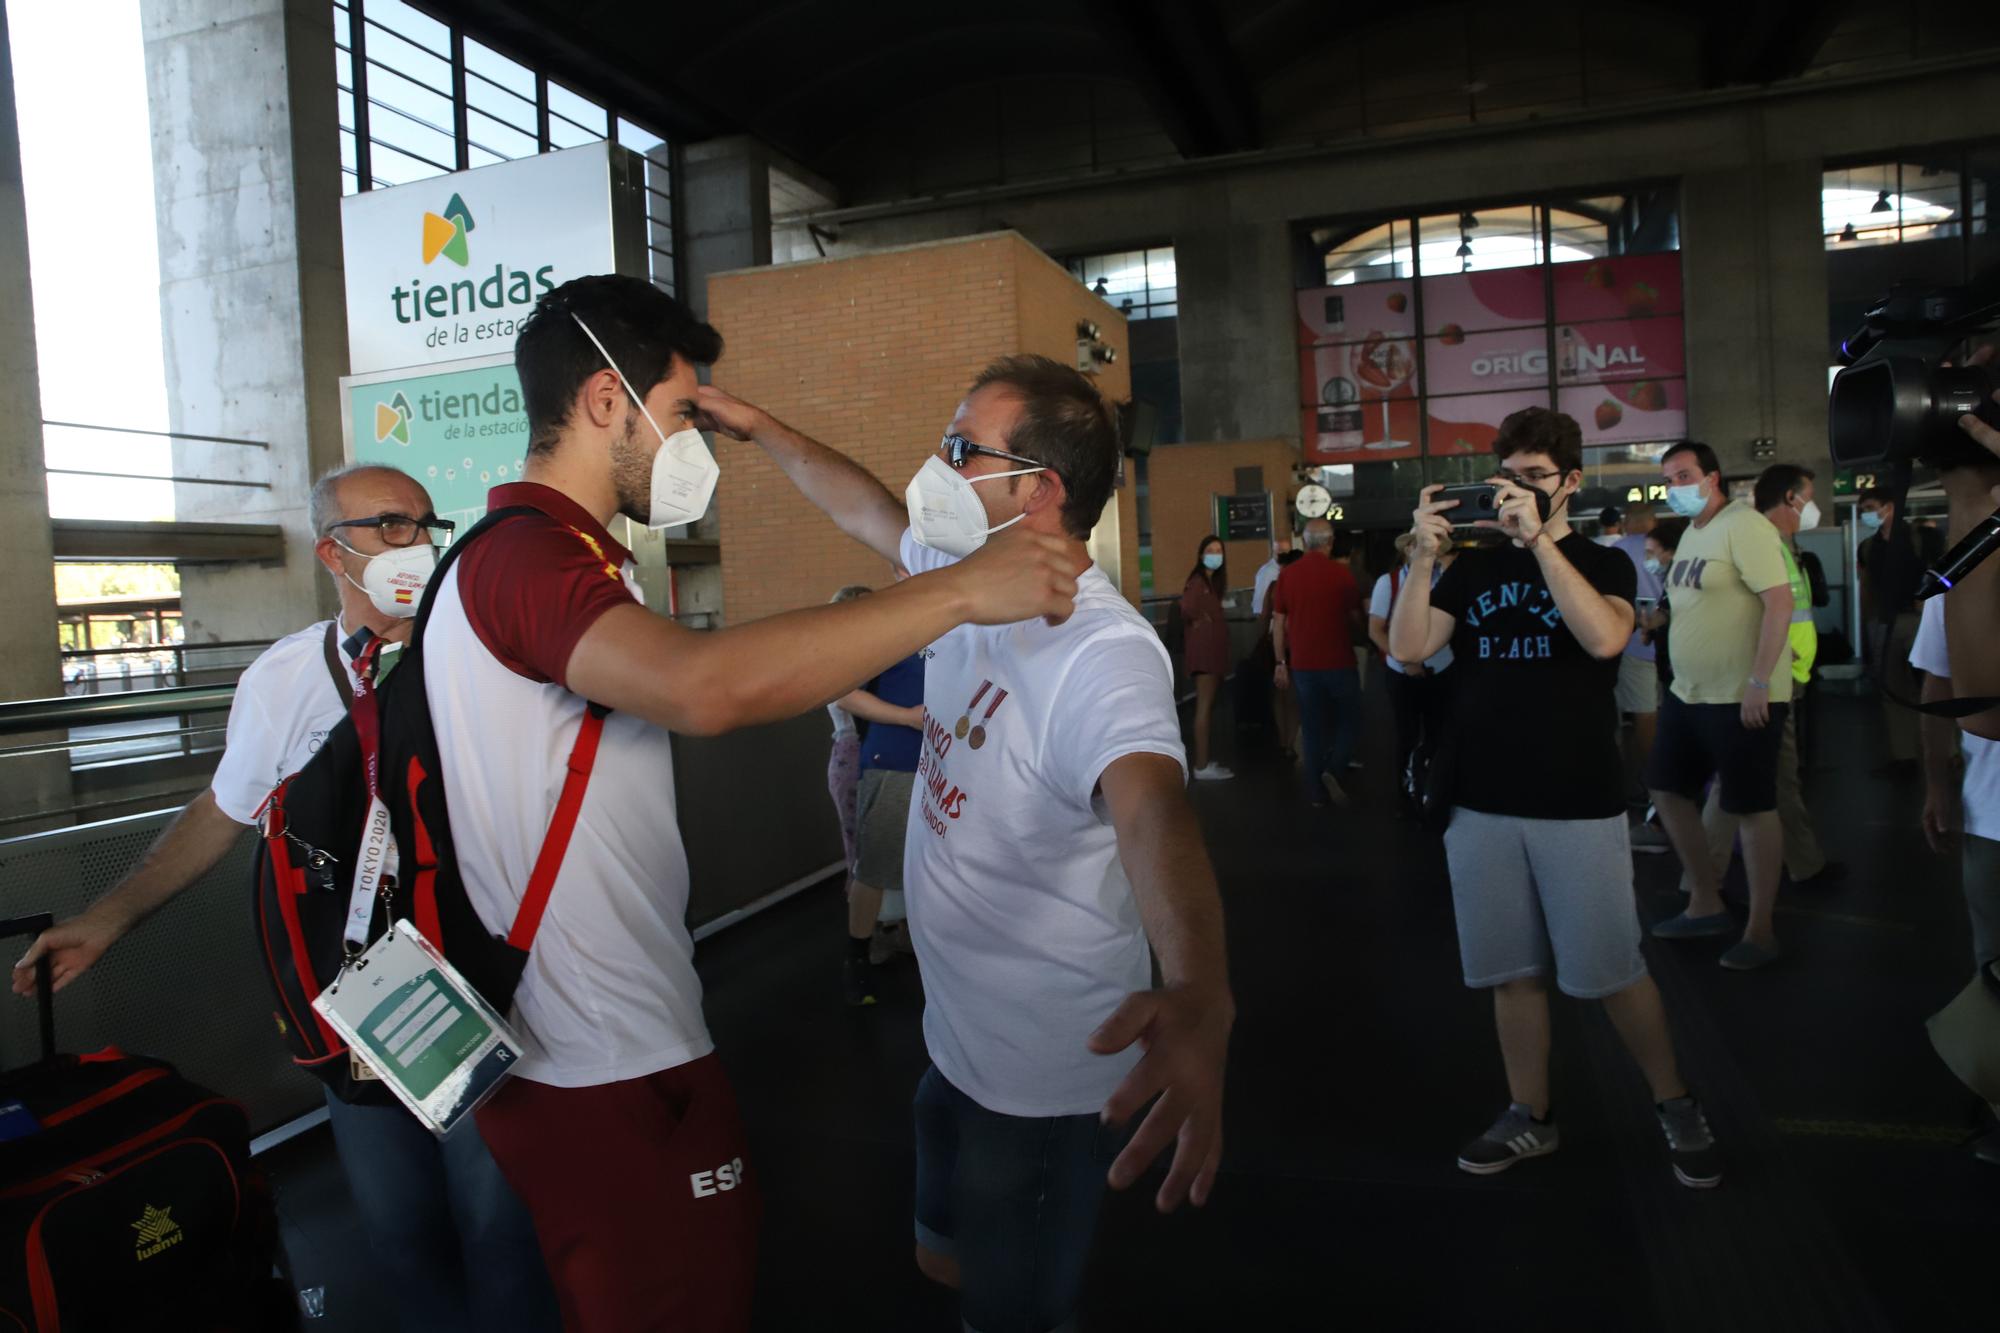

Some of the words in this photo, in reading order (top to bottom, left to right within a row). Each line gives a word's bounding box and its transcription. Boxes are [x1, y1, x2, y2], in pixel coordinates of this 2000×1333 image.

[391, 263, 555, 324] tiendas
[426, 326, 448, 348] de
[454, 323, 468, 344] la
[475, 317, 530, 340] estac
[1471, 344, 1645, 376] ORIGNAL
[419, 382, 526, 422] tienda
[444, 424, 460, 440] de
[464, 423, 476, 438] la
[479, 417, 529, 437] estació
[1856, 474, 1876, 489] P2
[1326, 506, 1344, 521] P2
[1479, 636, 1552, 659] BACH
[360, 846, 380, 892] TOKYO
[370, 810, 388, 845] 2020
[496, 1048, 510, 1062] R
[137, 1230, 183, 1261] luanvi
